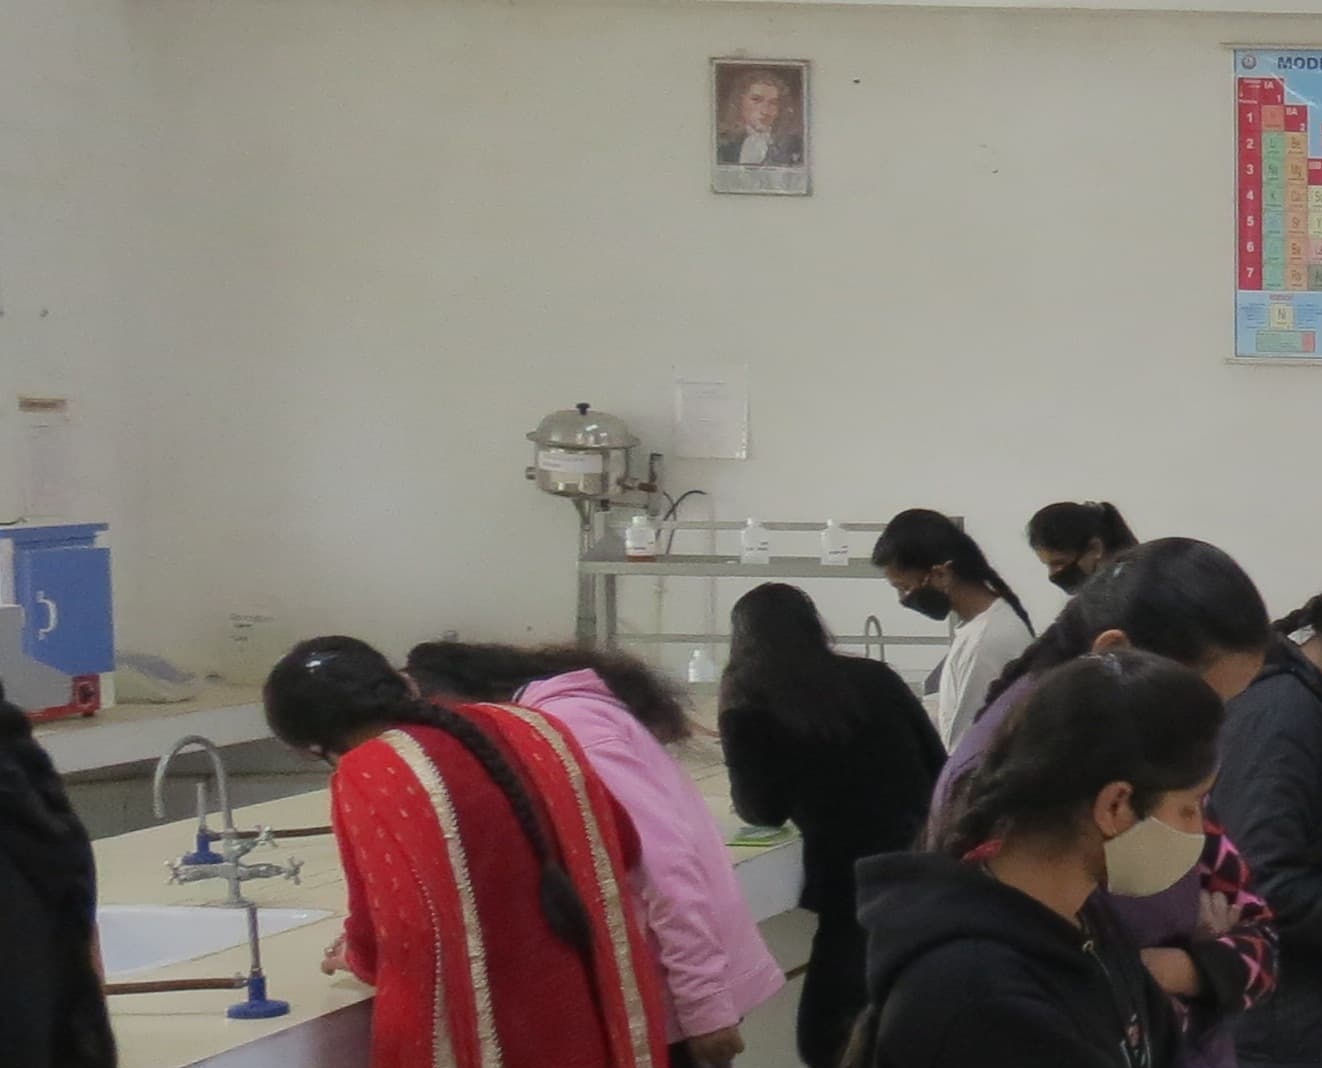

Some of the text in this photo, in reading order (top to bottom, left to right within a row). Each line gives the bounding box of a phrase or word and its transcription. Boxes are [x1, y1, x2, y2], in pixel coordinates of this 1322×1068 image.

[1246, 112, 1253, 123] 1
[1246, 138, 1254, 149] 2
[1246, 164, 1254, 176] 3
[1246, 190, 1254, 201] 4
[1246, 216, 1254, 227] 5
[1246, 241, 1254, 253] 6
[1246, 267, 1254, 279] 7
